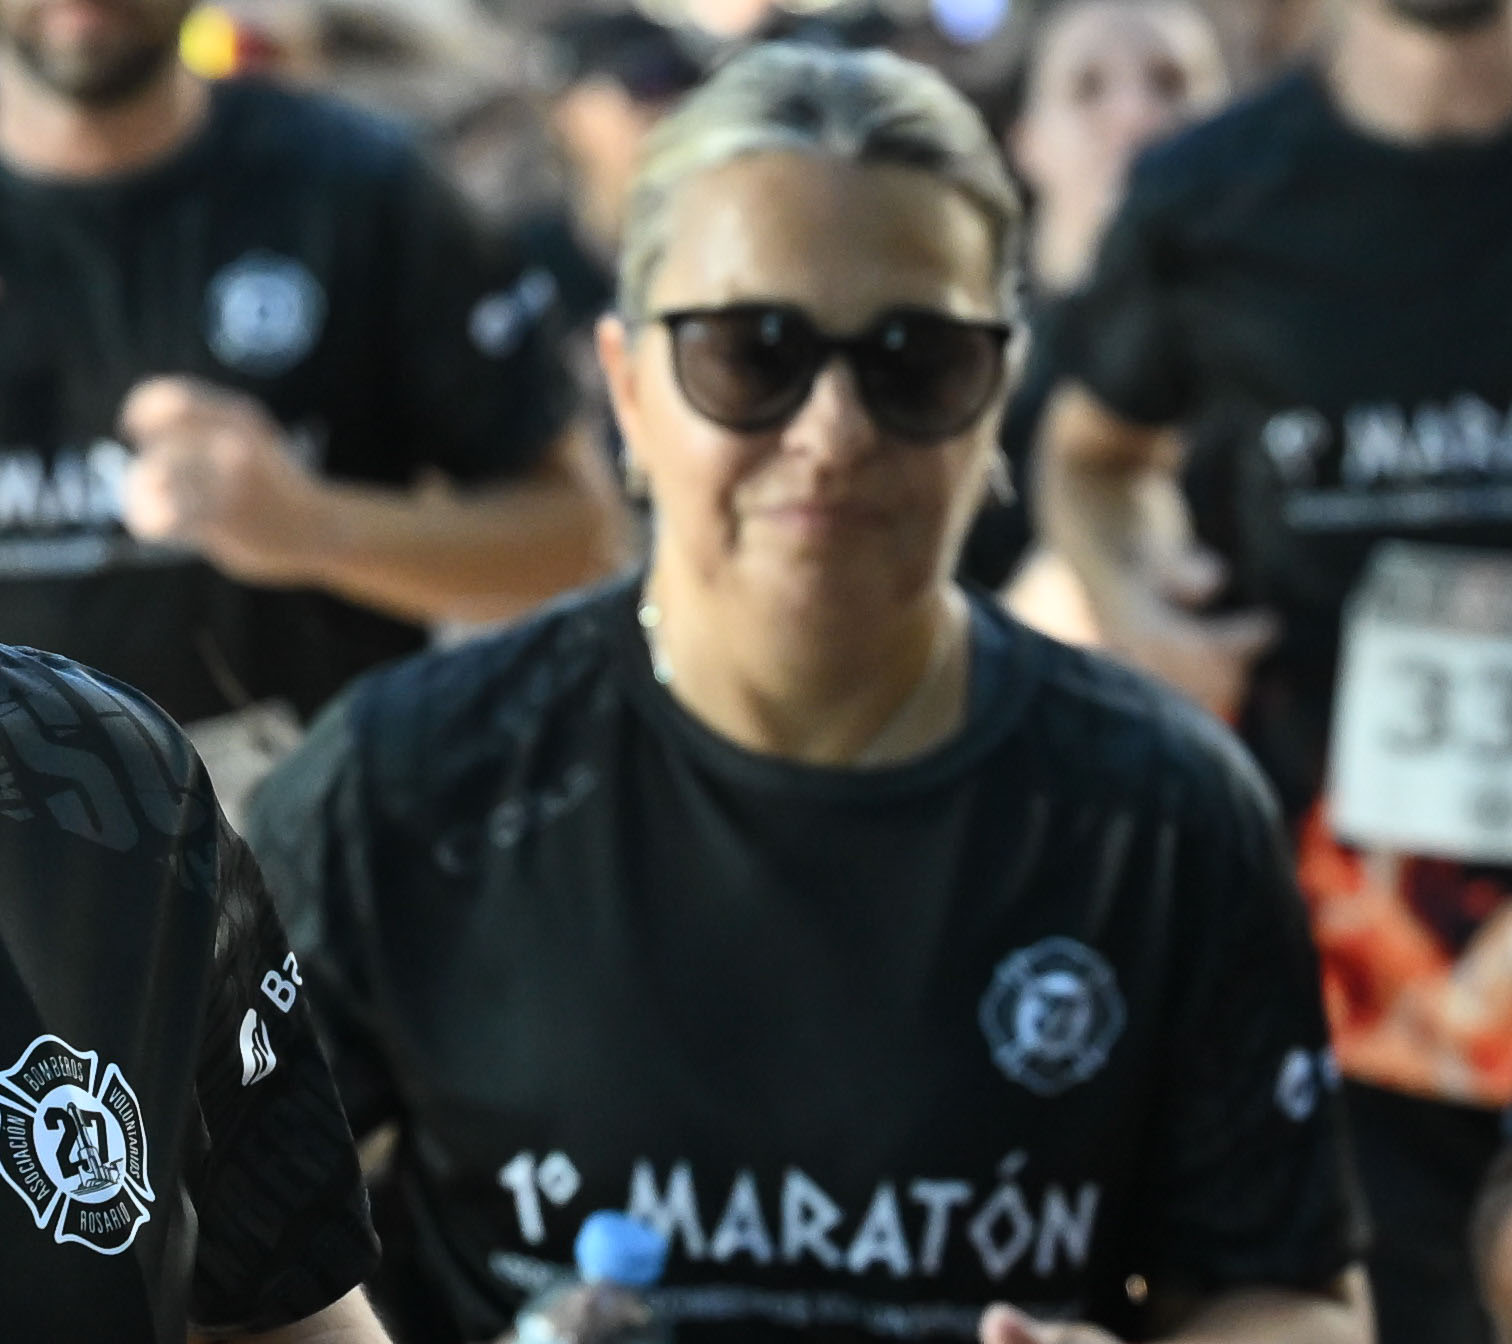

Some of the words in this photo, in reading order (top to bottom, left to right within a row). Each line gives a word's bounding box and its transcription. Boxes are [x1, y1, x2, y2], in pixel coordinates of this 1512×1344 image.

[23, 1055, 84, 1092] BOMBEROS
[2, 1114, 51, 1201] ASOCIACIÓN
[44, 1106, 109, 1180] 27
[108, 1086, 141, 1179] VOLUNTARIOS
[80, 1201, 131, 1234] ROSARIO
[629, 1152, 1101, 1280] MARATÓN
